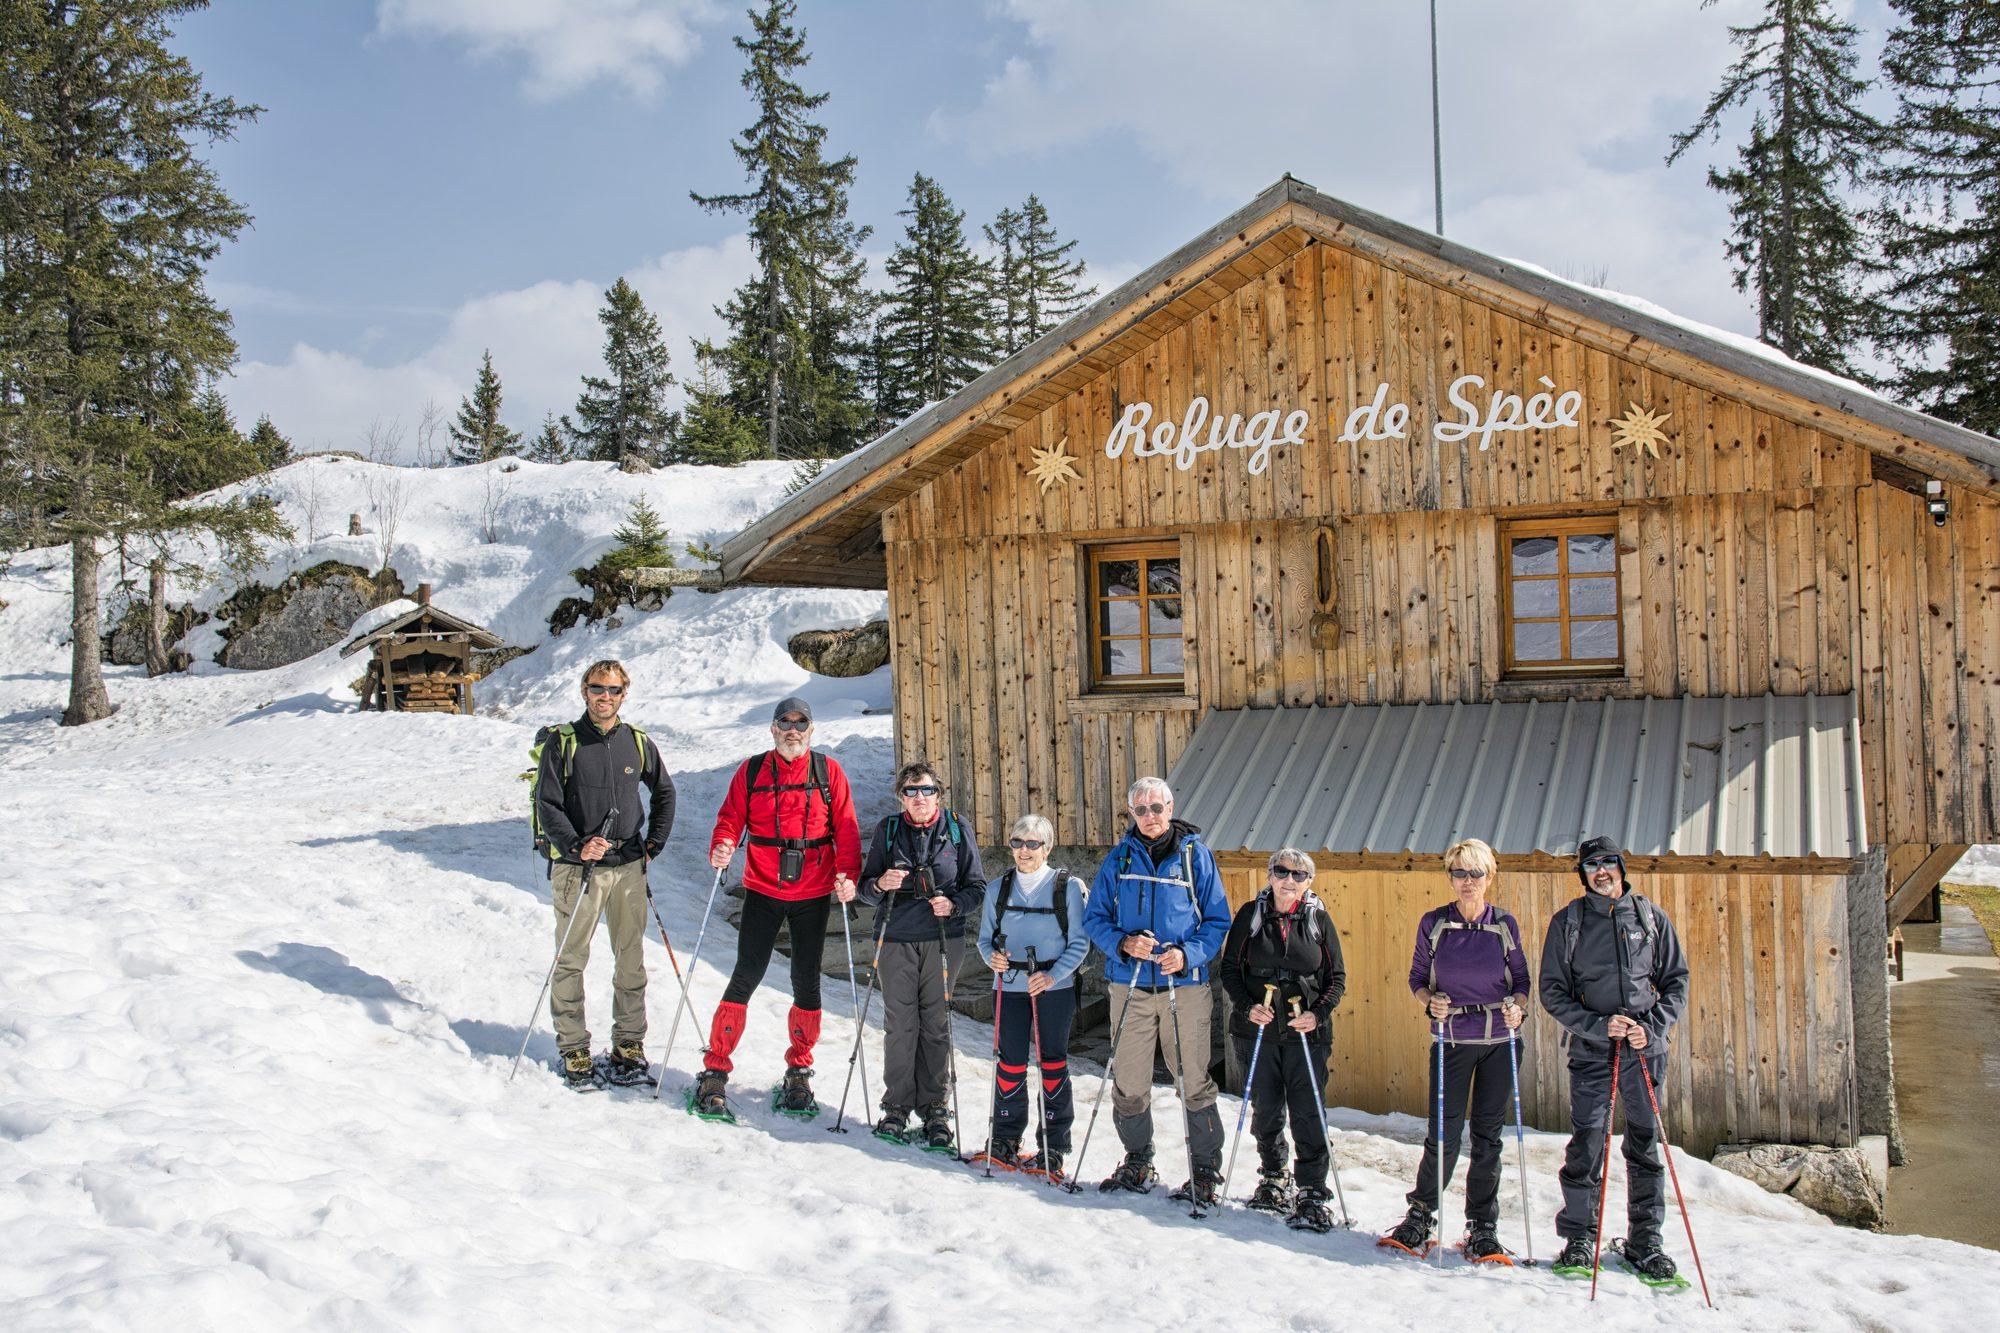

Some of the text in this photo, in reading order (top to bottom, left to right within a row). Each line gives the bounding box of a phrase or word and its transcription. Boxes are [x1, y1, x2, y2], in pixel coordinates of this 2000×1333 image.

[1105, 375, 1582, 476] Refuge de Spèe
